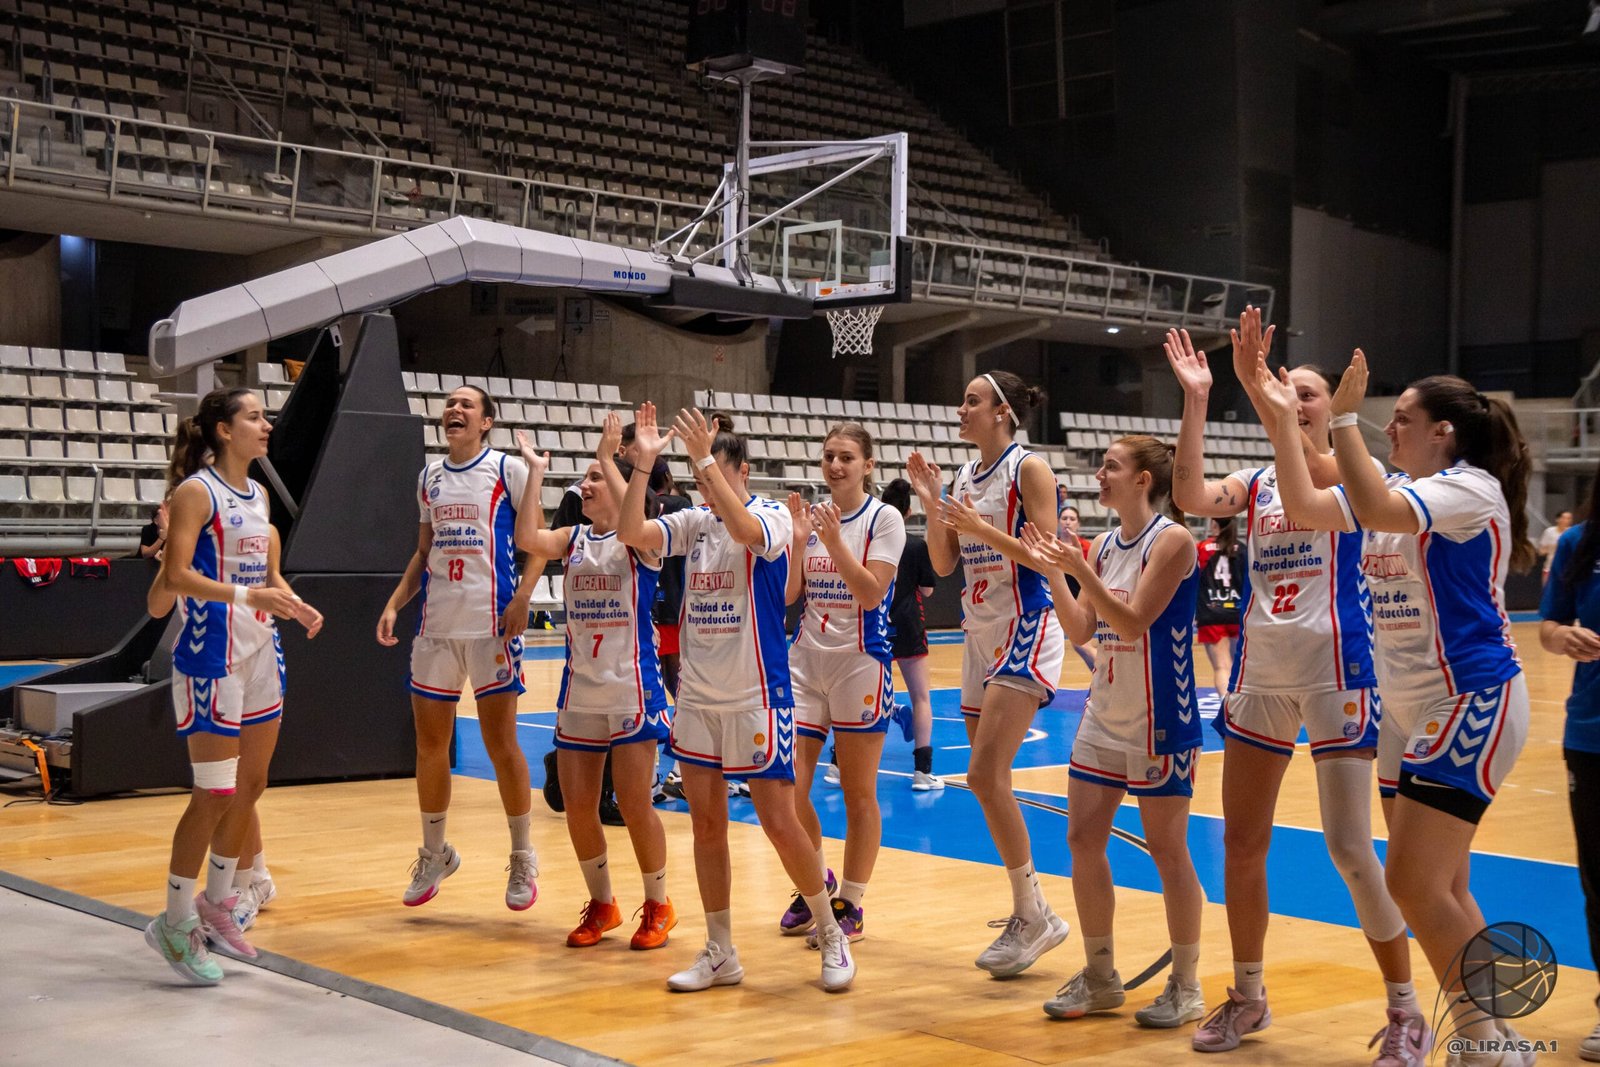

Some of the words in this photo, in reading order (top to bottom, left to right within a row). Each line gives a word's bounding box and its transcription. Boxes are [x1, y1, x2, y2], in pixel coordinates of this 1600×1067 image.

[613, 271, 646, 280] MONDO
[465, 527, 477, 537] de
[1298, 542, 1313, 554] de
[448, 558, 465, 582] 13
[1214, 555, 1232, 587] 4
[572, 574, 622, 592] LUCENTUM
[807, 579, 835, 589] Unidad
[836, 580, 847, 589] de
[972, 579, 989, 605] 12
[1271, 583, 1299, 614] 22
[1393, 590, 1408, 604] de
[574, 600, 606, 609] Unidad
[608, 599, 621, 608] de
[690, 602, 718, 613] Unidad
[721, 601, 735, 612] de
[569, 610, 629, 621] Reproducción
[688, 612, 742, 626] Reproducción
[592, 633, 604, 658] 7
